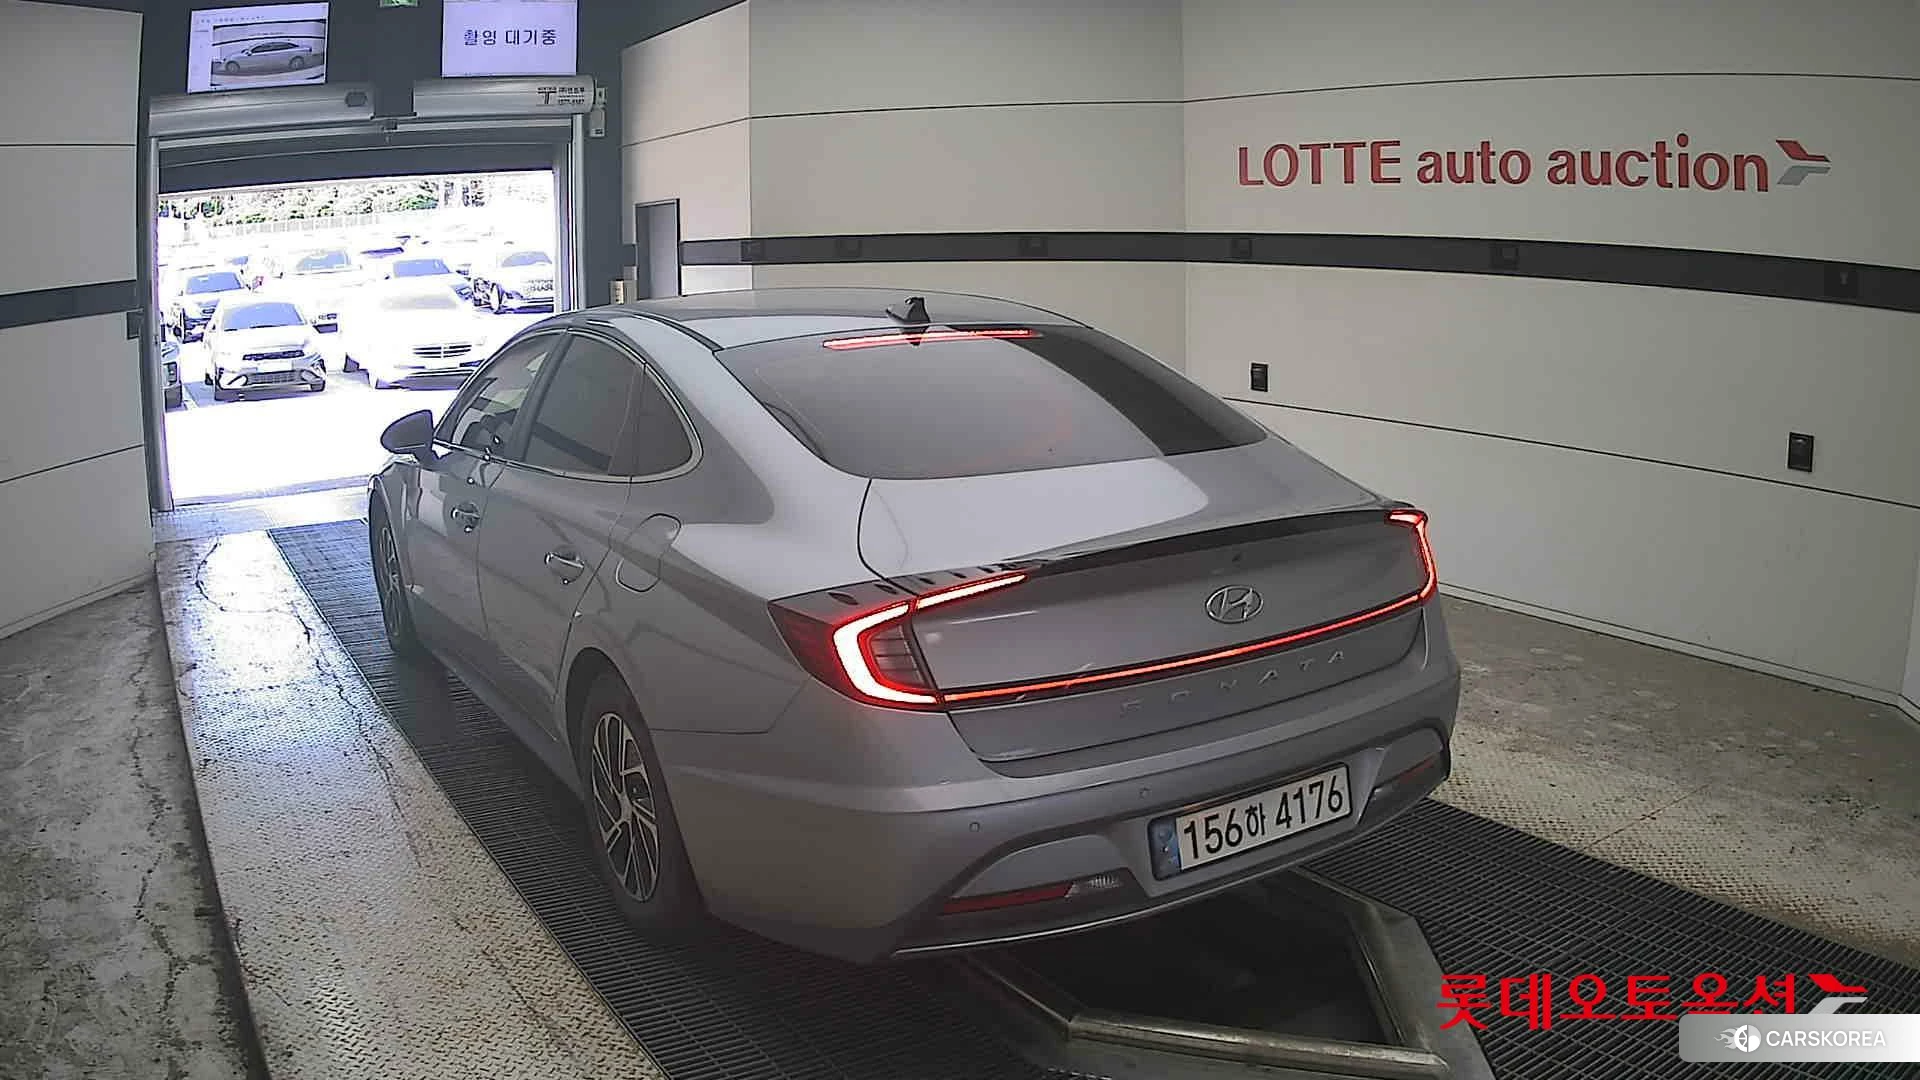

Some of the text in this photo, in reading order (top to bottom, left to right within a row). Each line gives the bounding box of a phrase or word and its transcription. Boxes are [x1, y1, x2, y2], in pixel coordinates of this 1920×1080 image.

[505, 29, 557, 46] 대기중
[1238, 133, 1769, 192] LOTTE auto auction
[1183, 775, 1344, 860] 156하 4176
